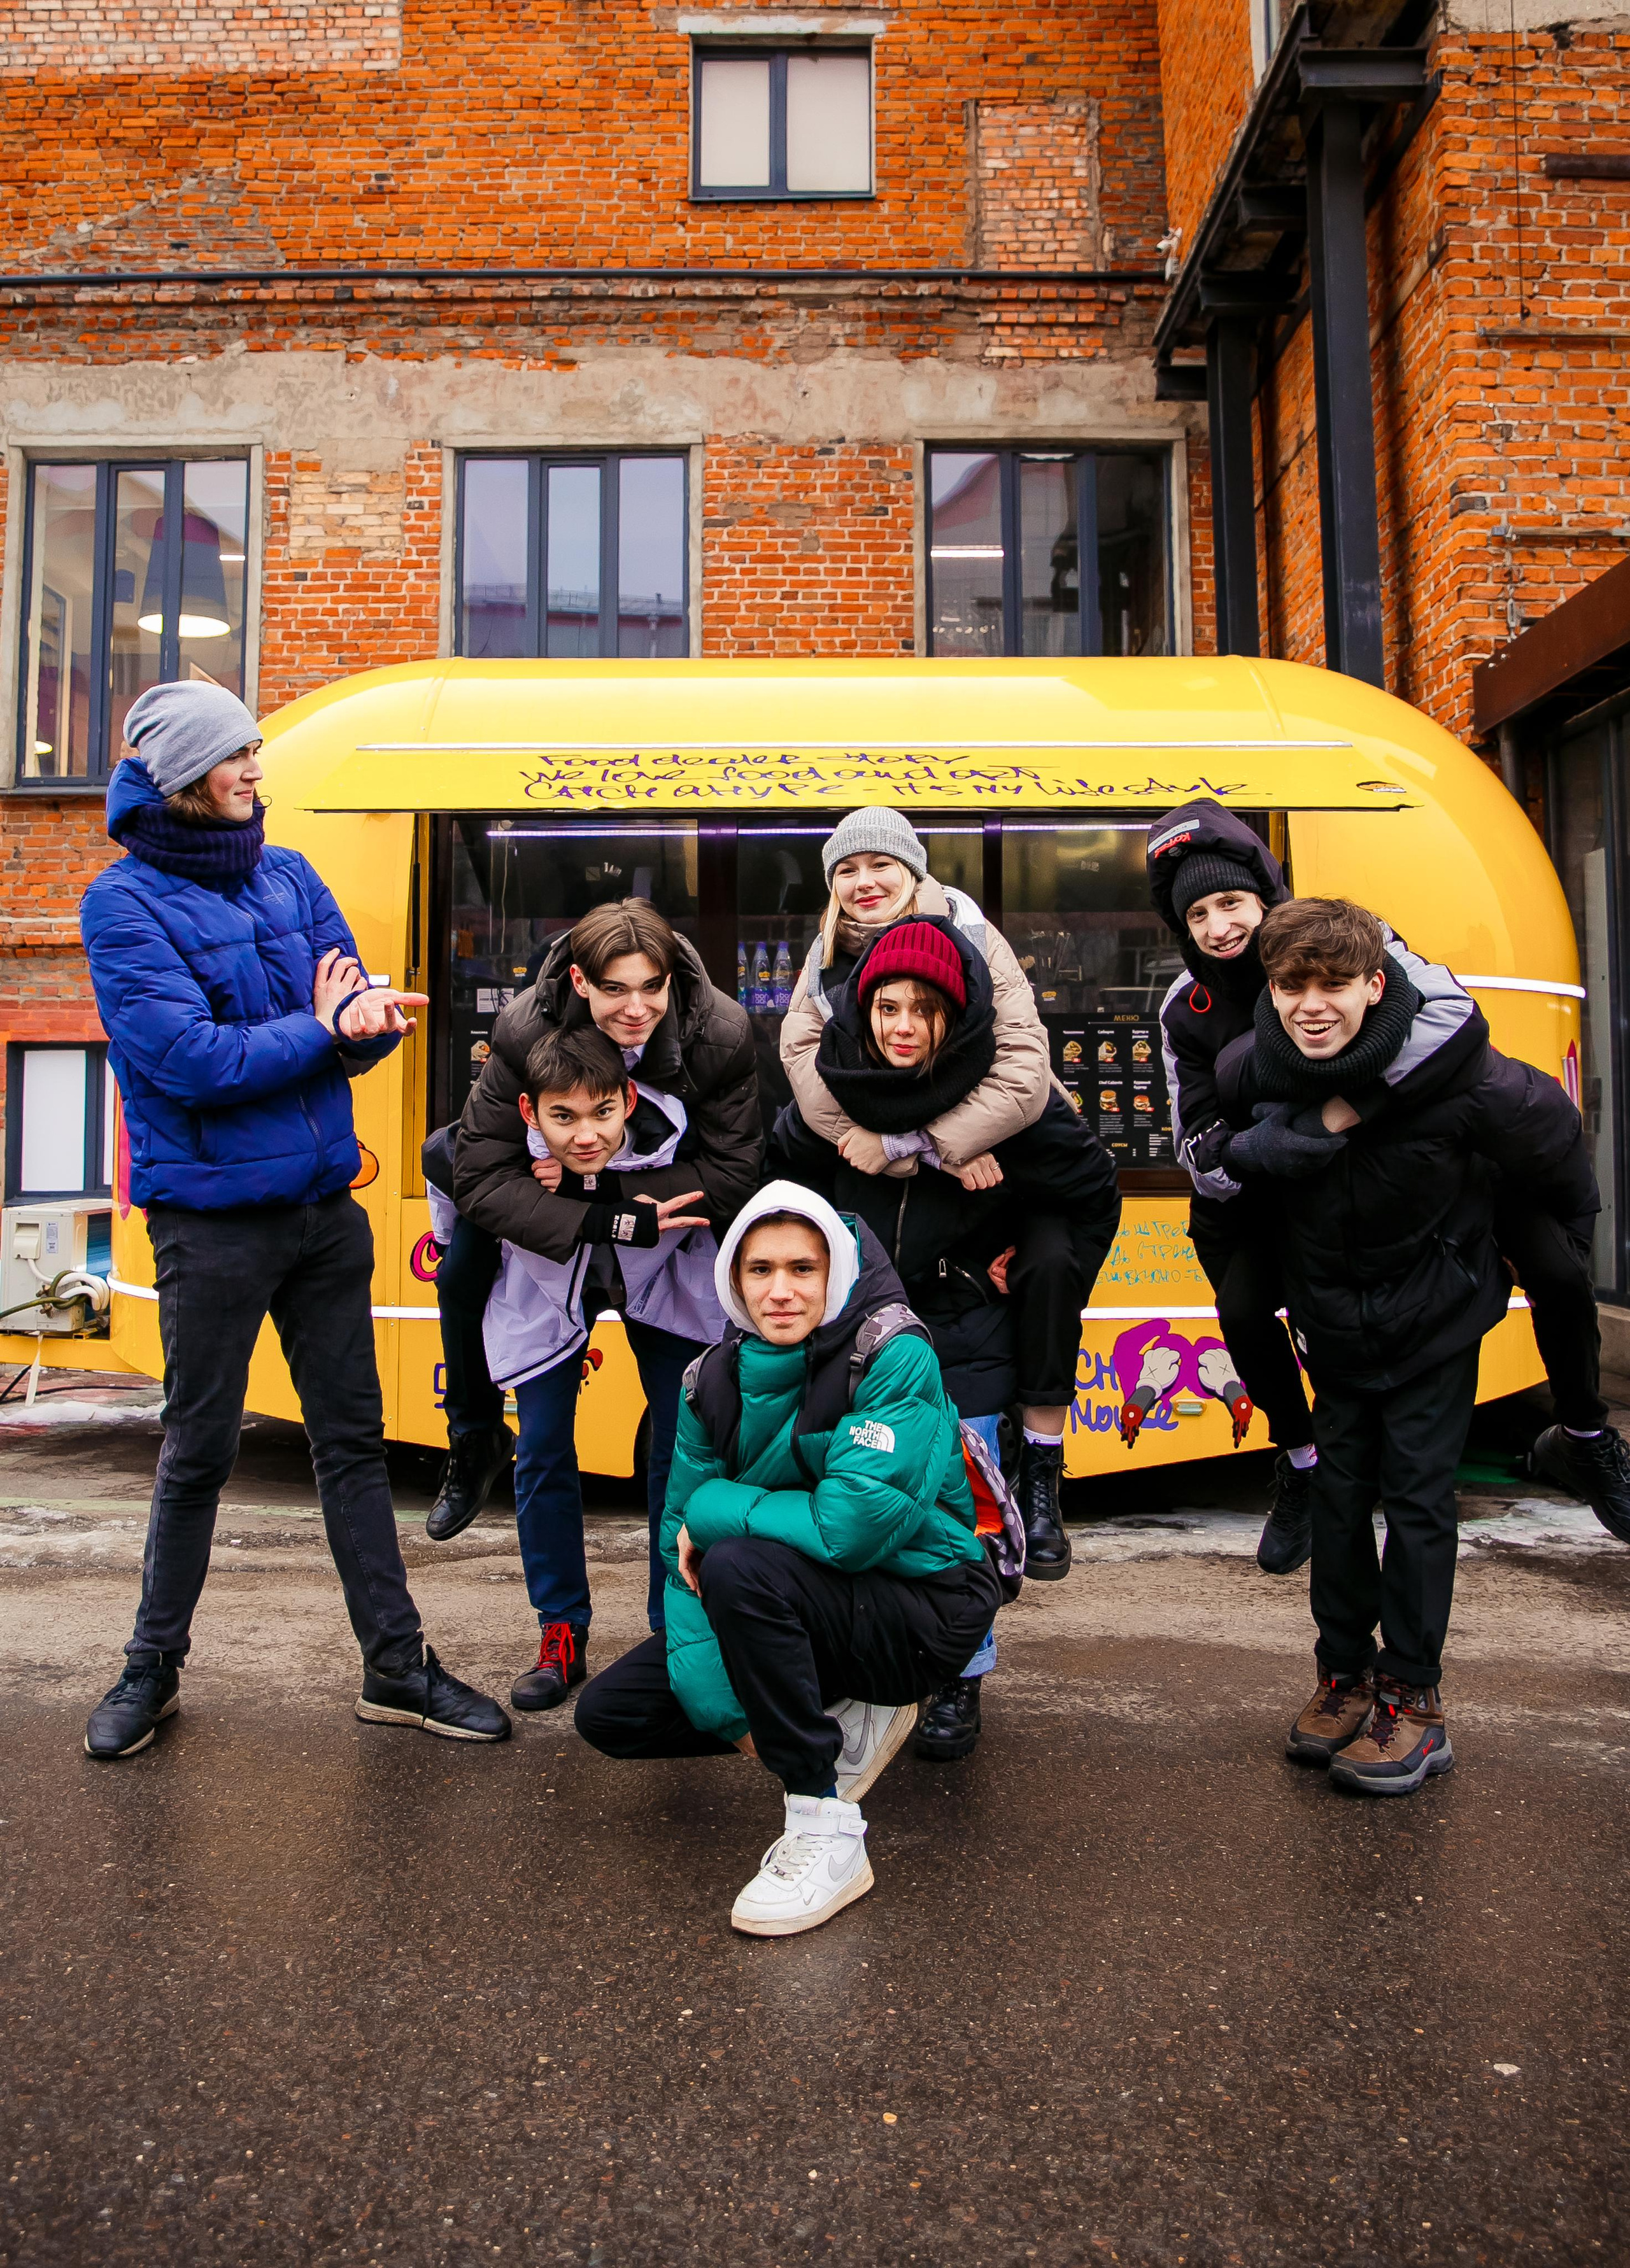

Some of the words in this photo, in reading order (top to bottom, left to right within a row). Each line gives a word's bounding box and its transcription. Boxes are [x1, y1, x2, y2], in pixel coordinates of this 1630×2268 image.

[537, 754, 641, 766] Food
[519, 770, 592, 782] We
[865, 1419, 882, 1432] THE
[849, 1425, 880, 1440] NORTH
[853, 1435, 878, 1449] FACE
